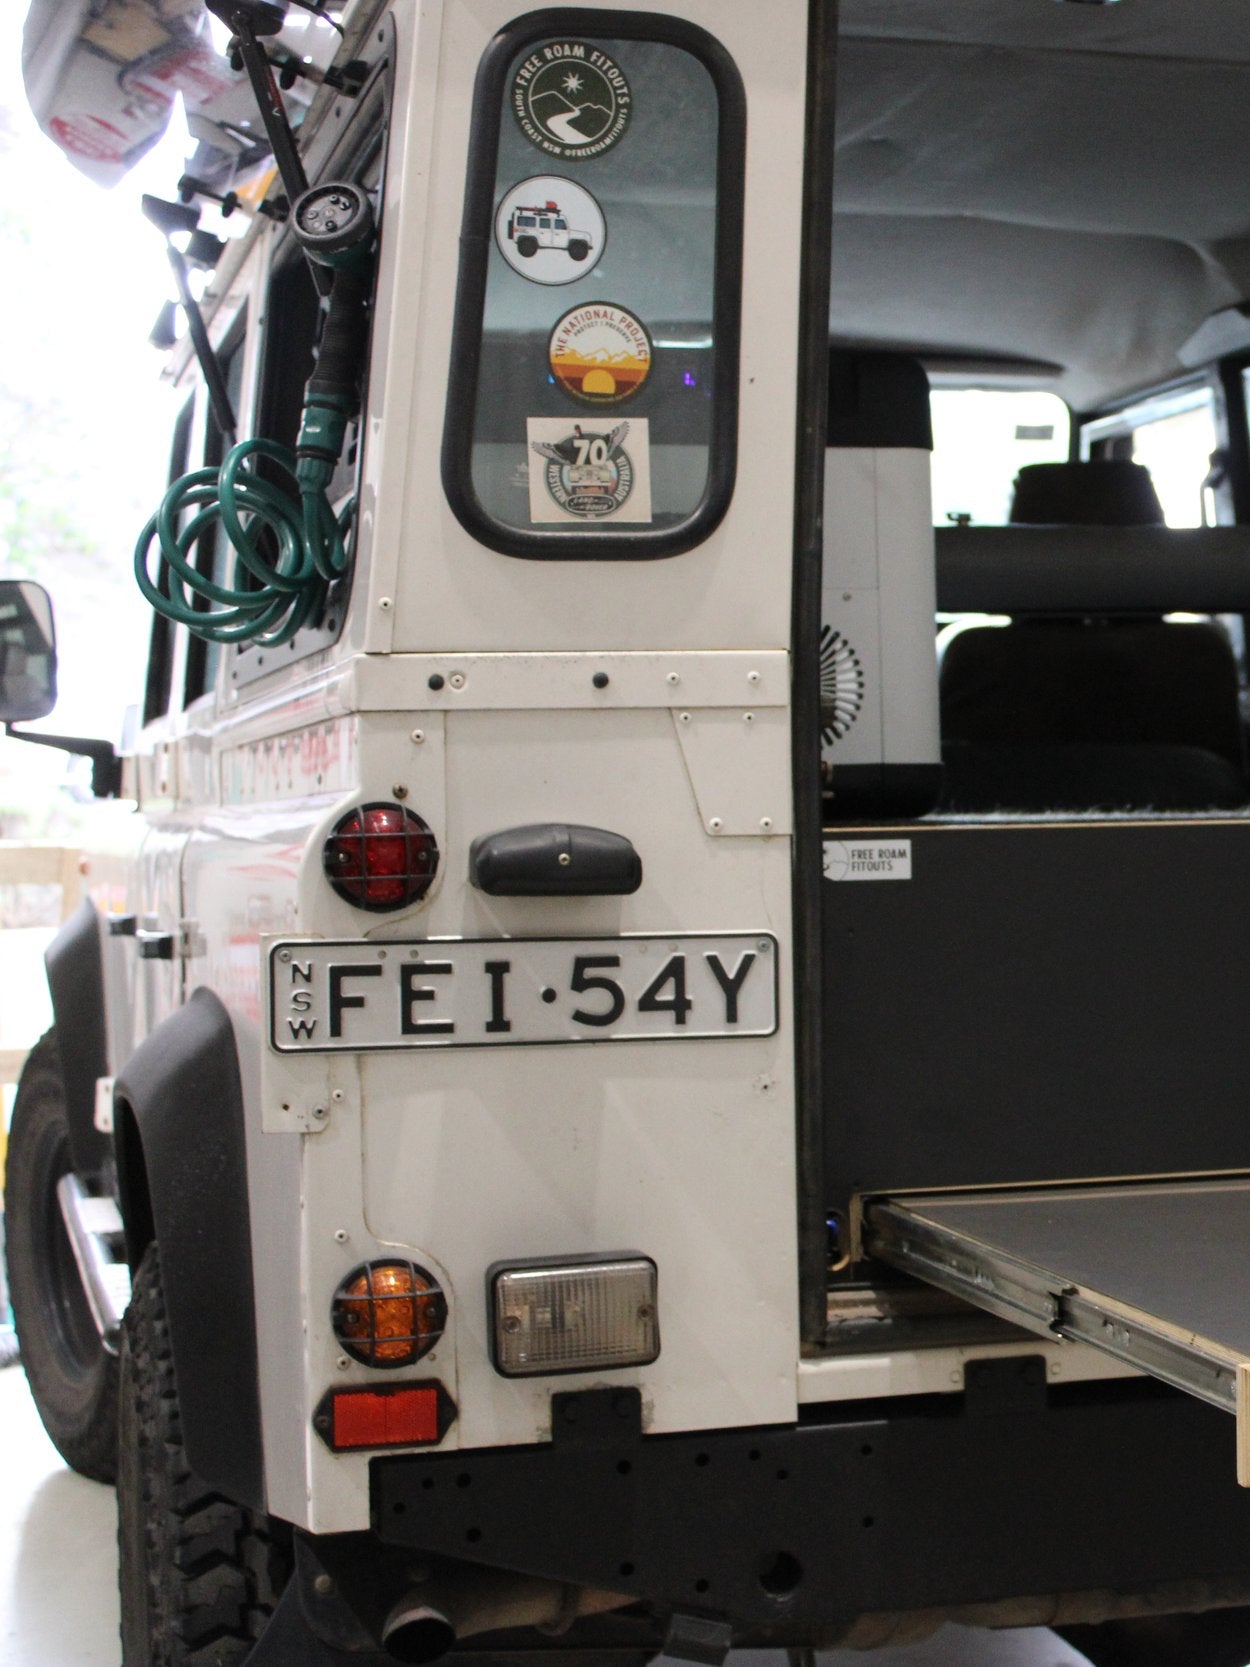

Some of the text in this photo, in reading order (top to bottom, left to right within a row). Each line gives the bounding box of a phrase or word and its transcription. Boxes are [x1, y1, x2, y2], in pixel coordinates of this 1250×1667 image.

[516, 44, 630, 104] FREE ROAM FITOUTS
[515, 88, 562, 155] SOUTH COAST NSW
[555, 309, 648, 363] THE NATIONAL PROJECT
[573, 438, 608, 465] 70
[614, 456, 632, 502] AUSTRALIA
[851, 848, 907, 860] FREE ROAM
[851, 860, 893, 872] FITOUTS
